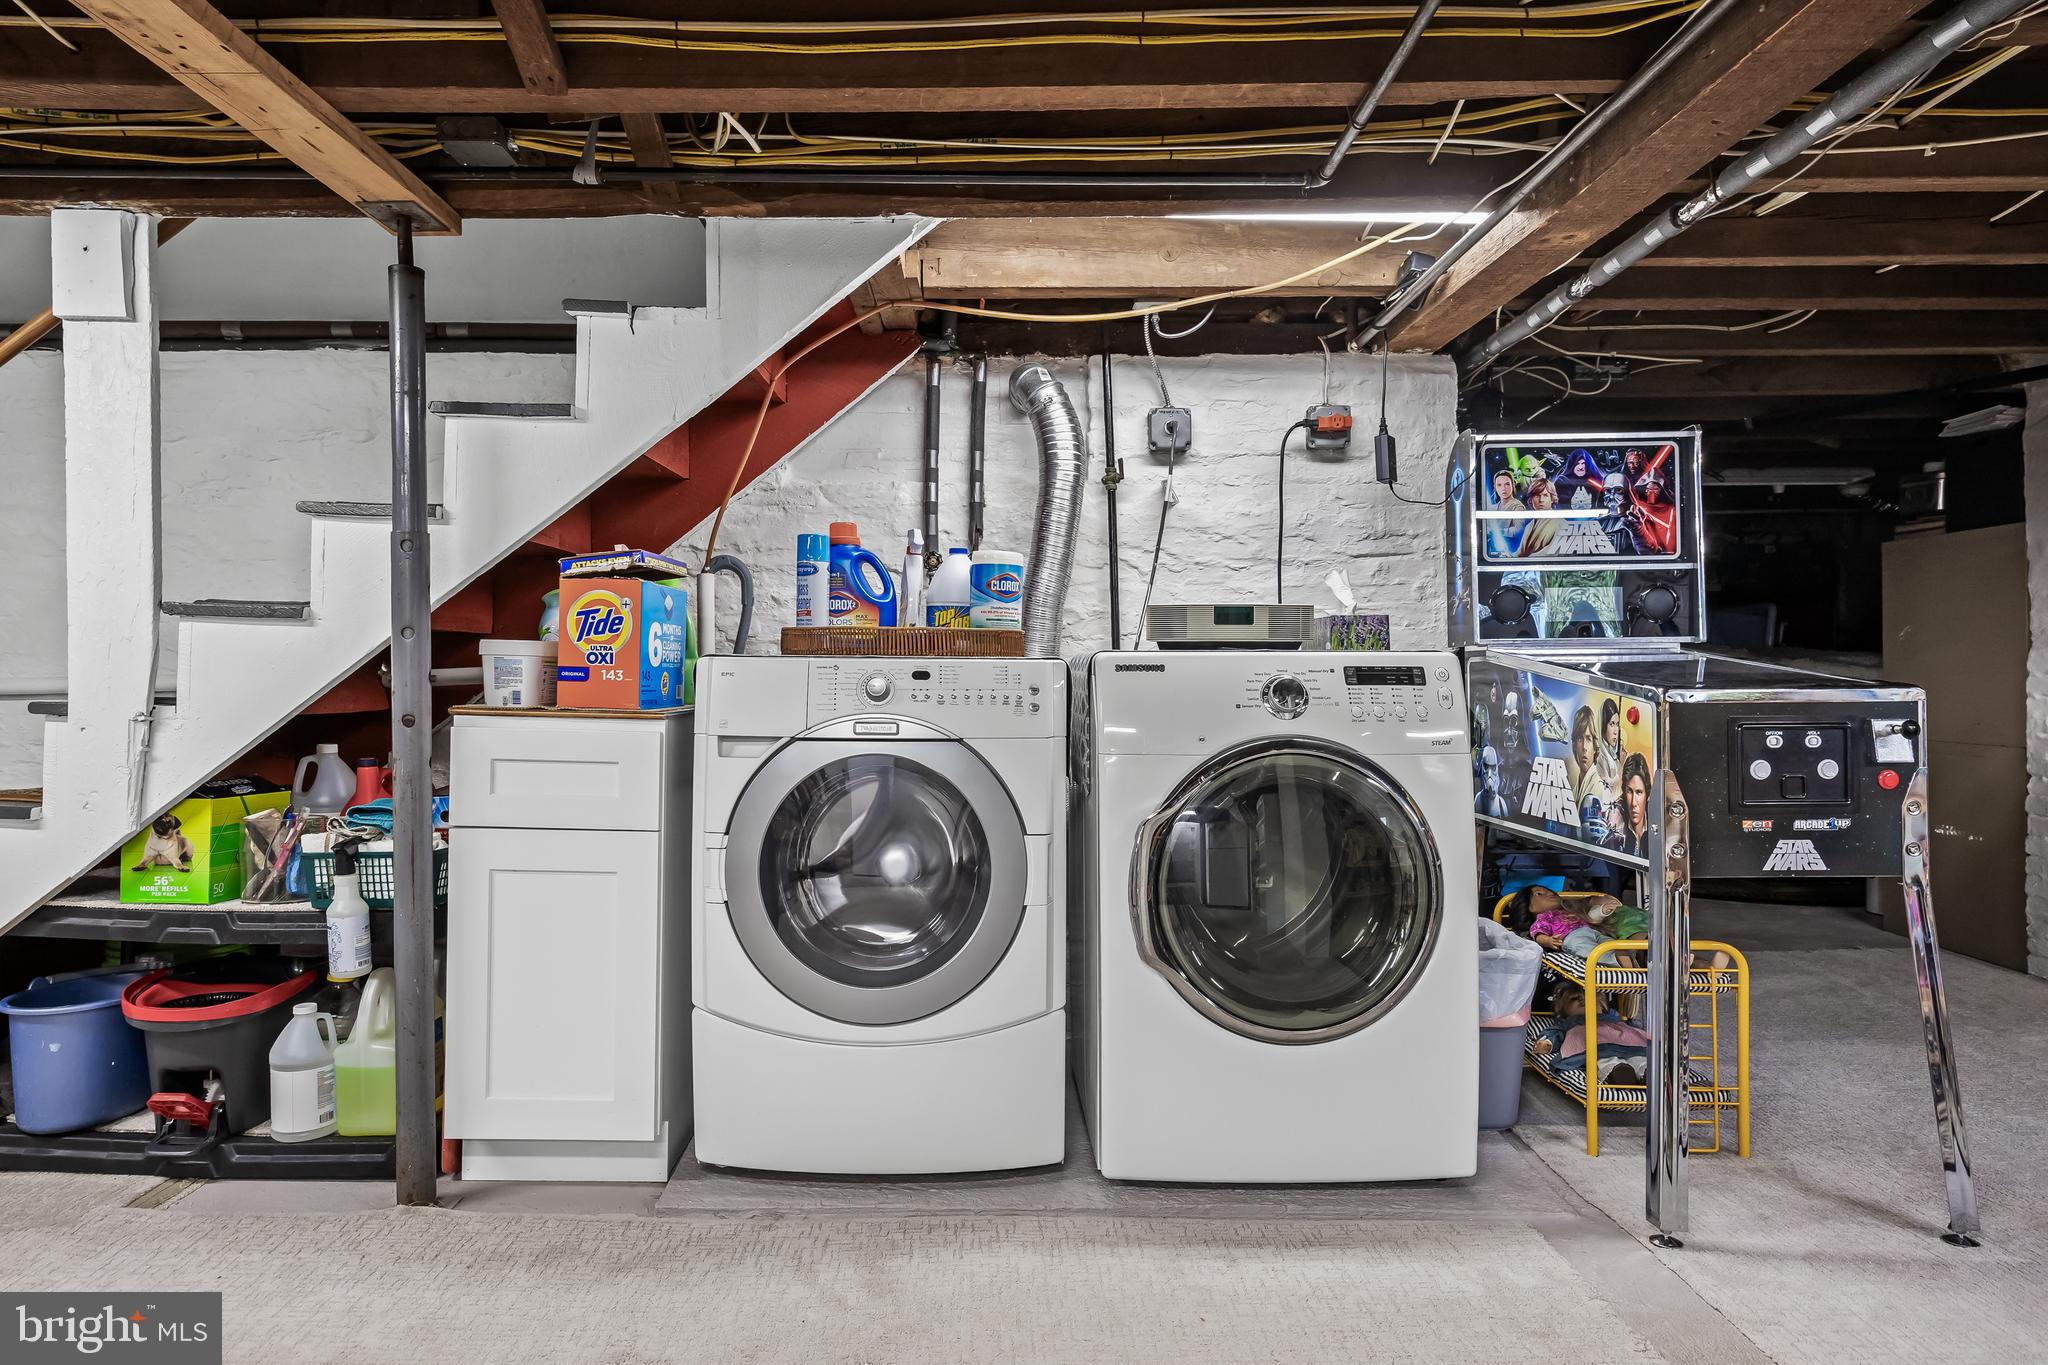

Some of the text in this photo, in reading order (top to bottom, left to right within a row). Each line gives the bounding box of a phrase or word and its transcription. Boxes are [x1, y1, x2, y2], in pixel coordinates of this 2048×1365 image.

[1557, 520, 1607, 536] STAR
[1546, 535, 1618, 554] WARS
[991, 580, 1019, 592] CLOROX
[935, 608, 955, 626] TOP
[575, 608, 625, 642] Tide
[662, 623, 682, 636] MONTHS
[648, 621, 663, 667] 6
[586, 652, 614, 665] OXI
[661, 650, 681, 663] POWER
[601, 669, 624, 681] 143
[1115, 664, 1166, 672] SAMSUNG
[1529, 756, 1572, 790] STAR
[1521, 781, 1581, 827] WARS
[1775, 839, 1816, 854] STAR
[1762, 853, 1827, 871] WARS
[213, 882, 224, 895] 50
